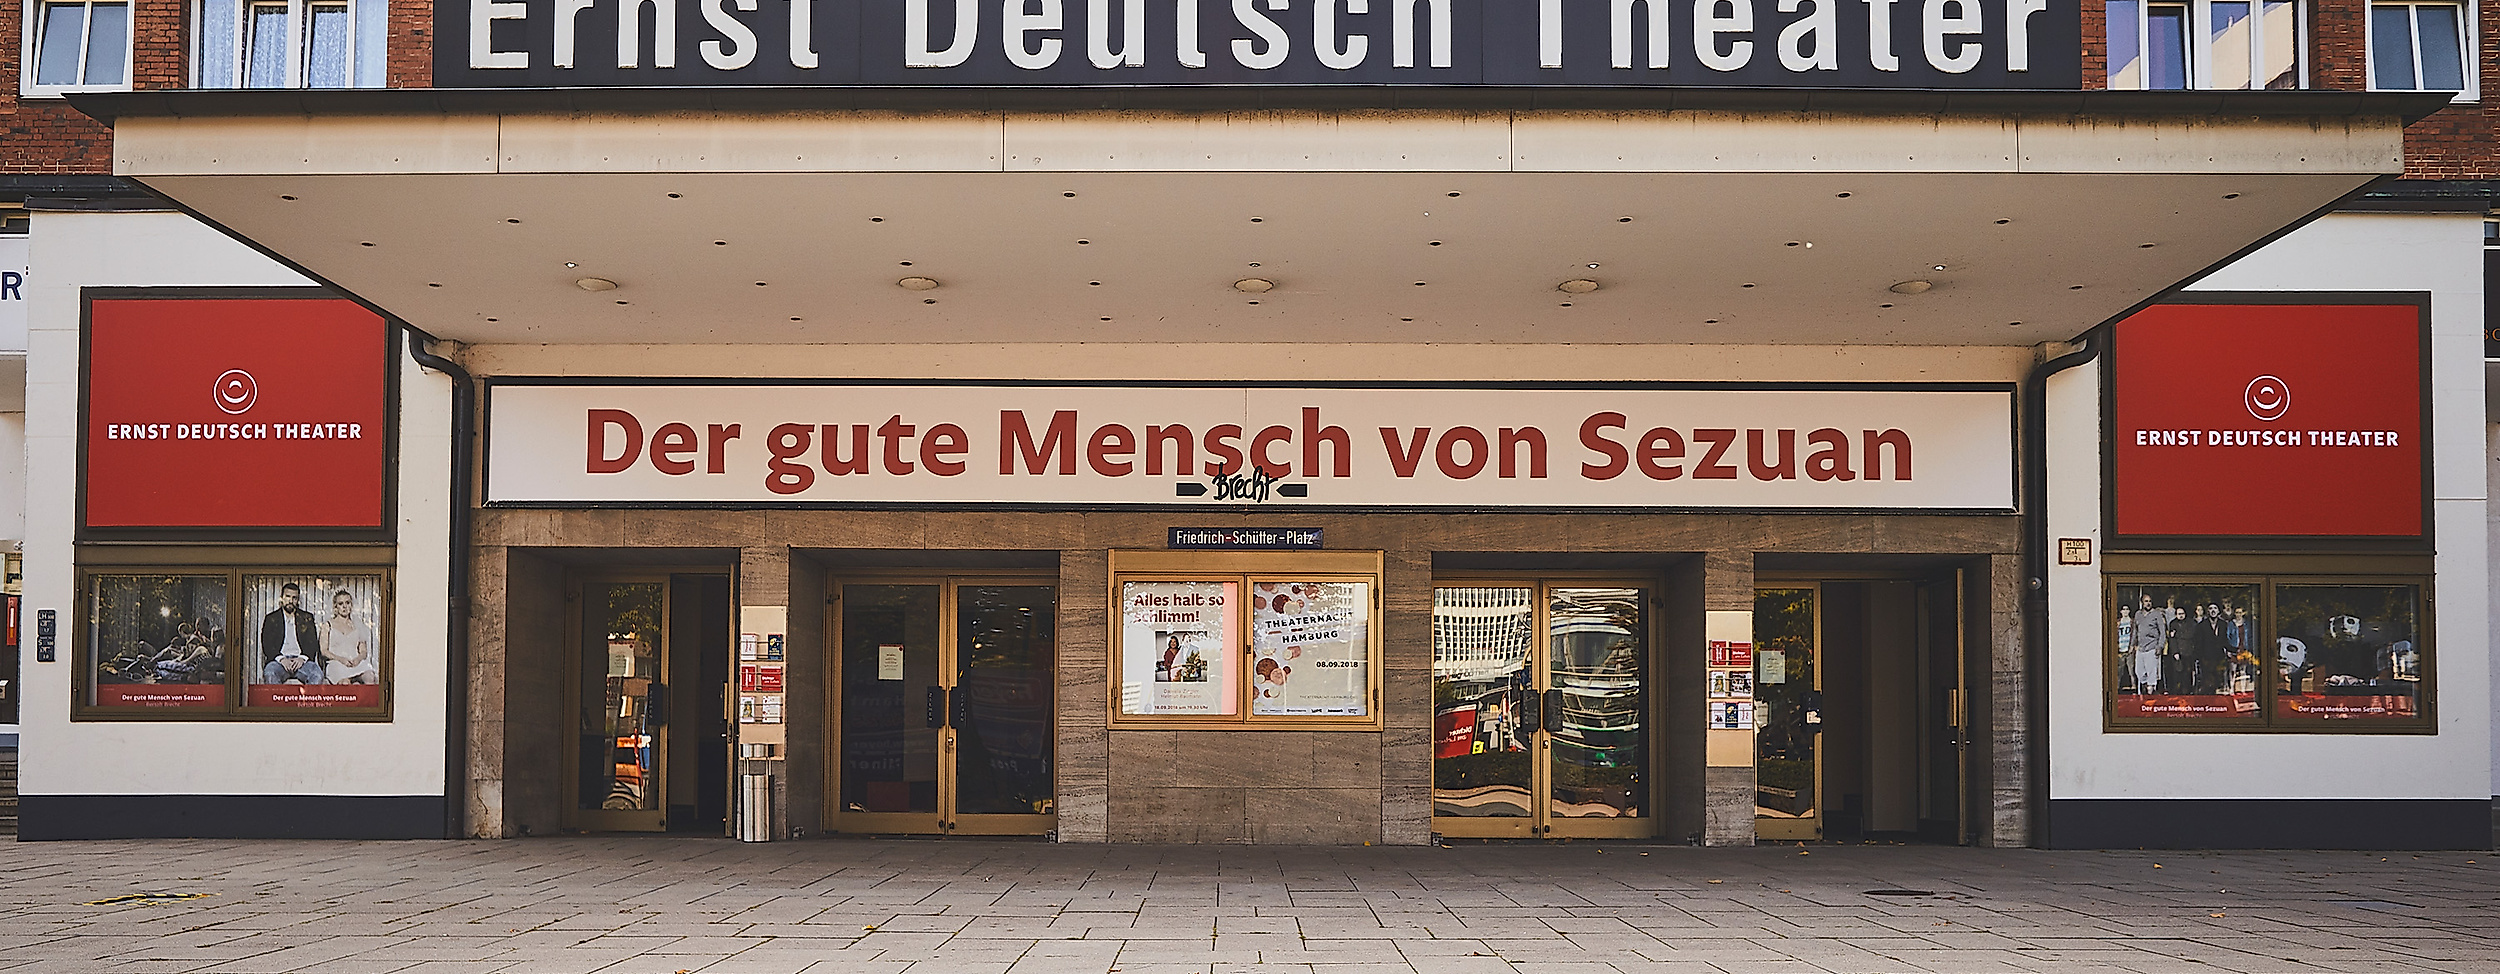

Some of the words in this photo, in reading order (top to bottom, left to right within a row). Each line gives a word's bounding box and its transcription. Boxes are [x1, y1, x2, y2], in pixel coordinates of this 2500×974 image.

[469, 0, 820, 70] Ernst
[905, 0, 1452, 70] Deutsch
[1539, 0, 2047, 73] Theater
[108, 423, 171, 440] ERNST
[177, 423, 267, 440] DEUTSCH
[274, 423, 362, 440] THEATER
[2136, 430, 2202, 447] ERNST
[2208, 430, 2301, 447] DEUTSCH
[2307, 430, 2399, 447] THEATER
[586, 408, 741, 475] Der
[765, 414, 969, 495] gute
[999, 407, 1352, 478] Mensch
[1379, 426, 1548, 479] von
[1579, 411, 1912, 482] Sezuan
[1212, 462, 1279, 503] Brecht
[1134, 593, 1169, 606] Alles
[1173, 593, 1205, 606] halb
[1208, 595, 1225, 606] so
[1133, 609, 1200, 623] schlimm!
[1281, 630, 1338, 644] HAMBURG
[133, 694, 147, 702] gute
